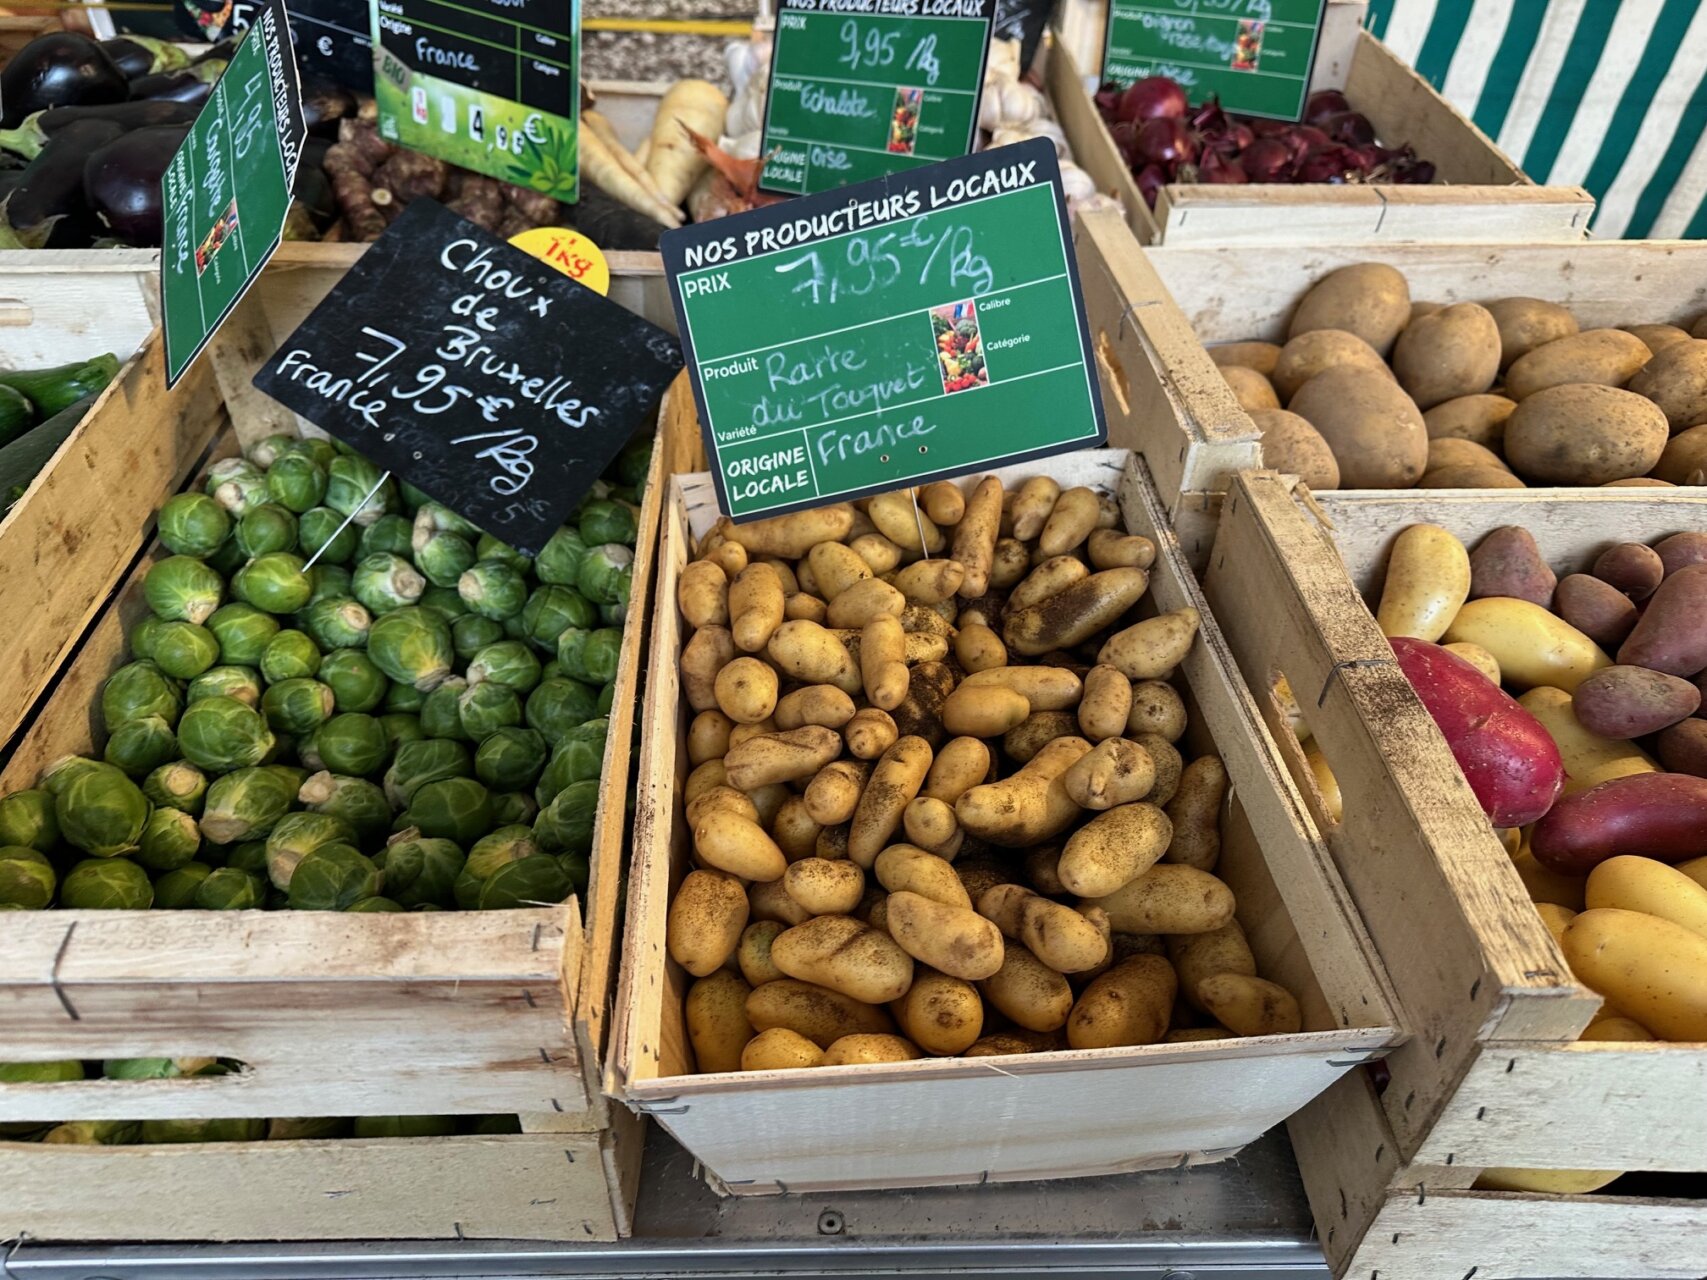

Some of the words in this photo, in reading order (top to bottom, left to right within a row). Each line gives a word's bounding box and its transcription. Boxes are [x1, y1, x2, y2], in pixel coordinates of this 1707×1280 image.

[263, 6, 278, 41] NOS
[922, 0, 982, 17] LOCAUX
[416, 37, 480, 71] France
[267, 36, 291, 134] PRODUCTEURS
[684, 241, 738, 267] NOS
[745, 190, 921, 256] PRODUCTEURS
[930, 160, 1038, 208] LOCAUX
[440, 239, 554, 317] Choux
[684, 272, 732, 298] PRIX
[451, 293, 498, 331] de
[979, 296, 1011, 312] Calibre
[986, 332, 1031, 352] Catégorie
[436, 325, 600, 428] Bruxelles
[704, 357, 759, 381] Produit
[276, 350, 388, 428] France
[717, 424, 757, 442] Variété
[816, 413, 937, 466] France
[726, 447, 806, 478] ORIGINE
[732, 470, 809, 502] LOCALE
